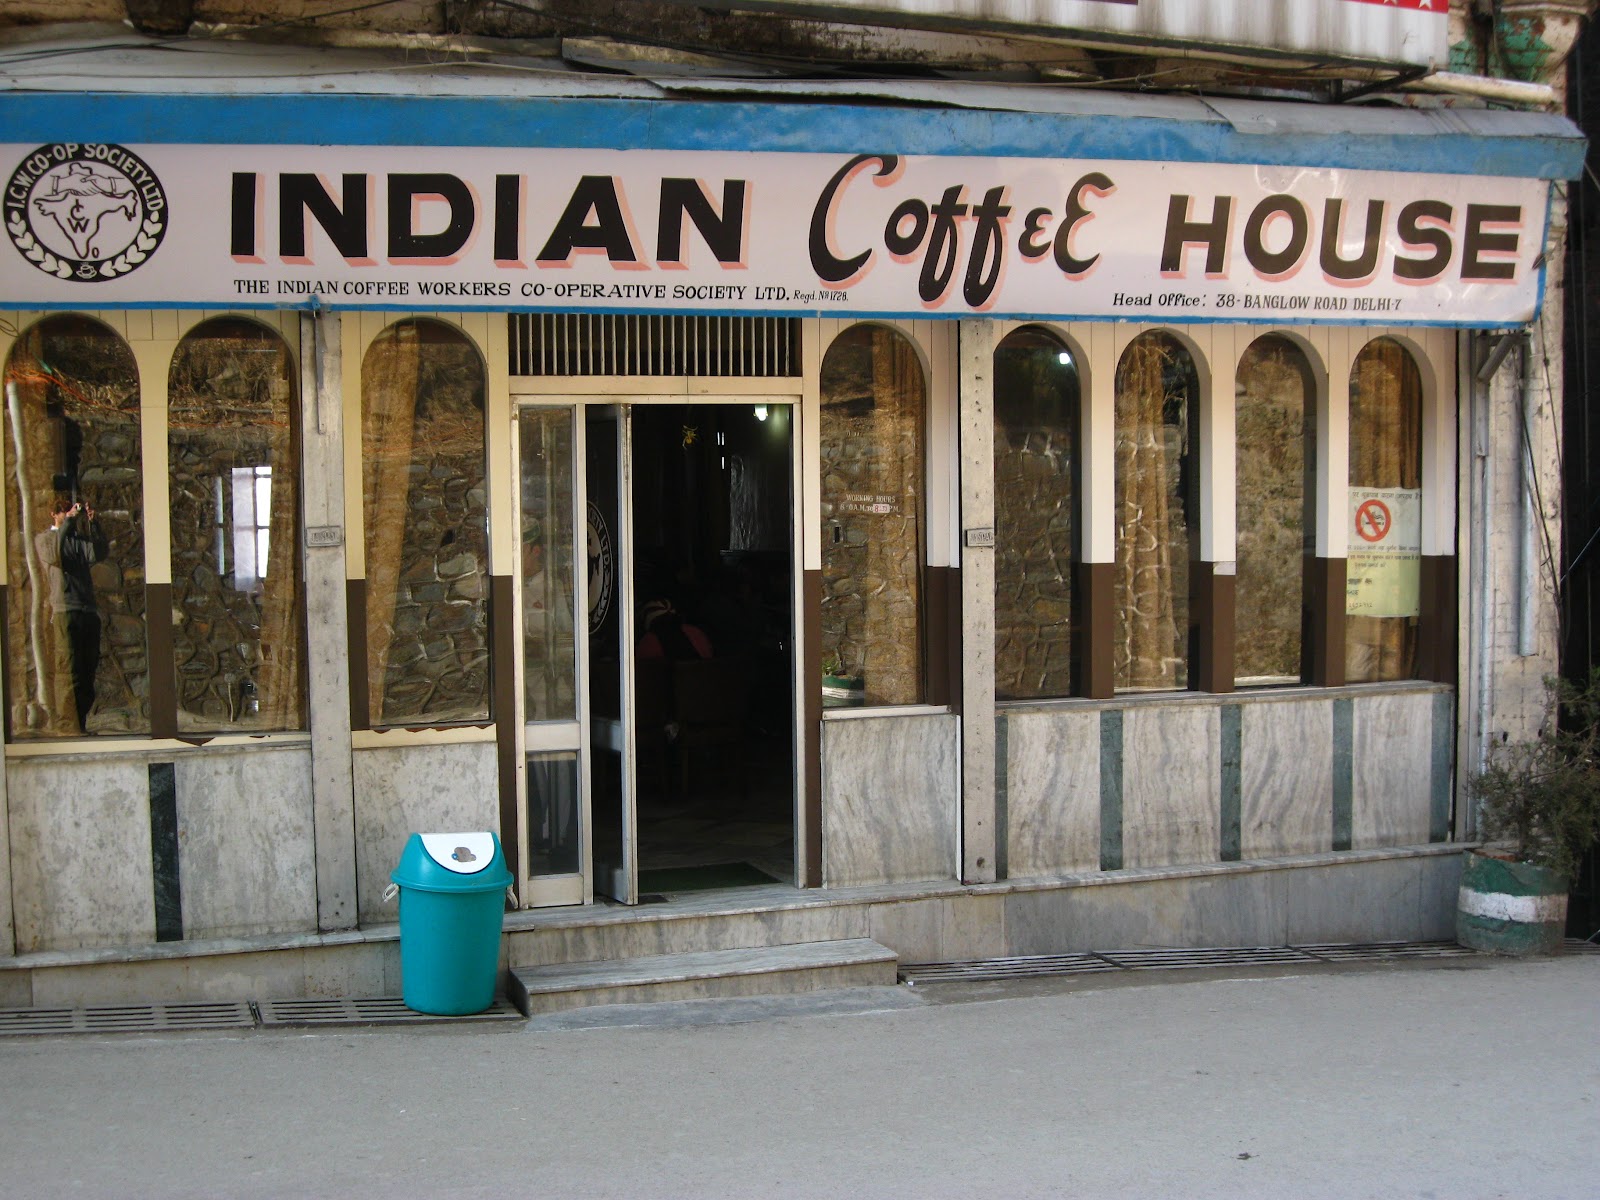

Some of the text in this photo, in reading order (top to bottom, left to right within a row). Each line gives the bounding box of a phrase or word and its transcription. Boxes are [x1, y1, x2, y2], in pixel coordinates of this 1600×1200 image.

[84, 143, 153, 184] SOCIETY
[142, 182, 164, 211] LTD
[230, 171, 750, 268] INDIAN
[1160, 193, 1524, 286] HOUSE
[233, 280, 269, 294] THE
[277, 280, 339, 295] INDIAN
[343, 281, 409, 296] COFFEE
[418, 282, 511, 297] WORKERS
[521, 282, 666, 299] CO-OPERATIVE
[672, 285, 747, 300] SOCIETY
[755, 286, 790, 301] LTD.
[1112, 293, 1152, 307] Head
[1314, 296, 1348, 311] ROAD
[845, 493, 896, 504] WORKING HOURS
